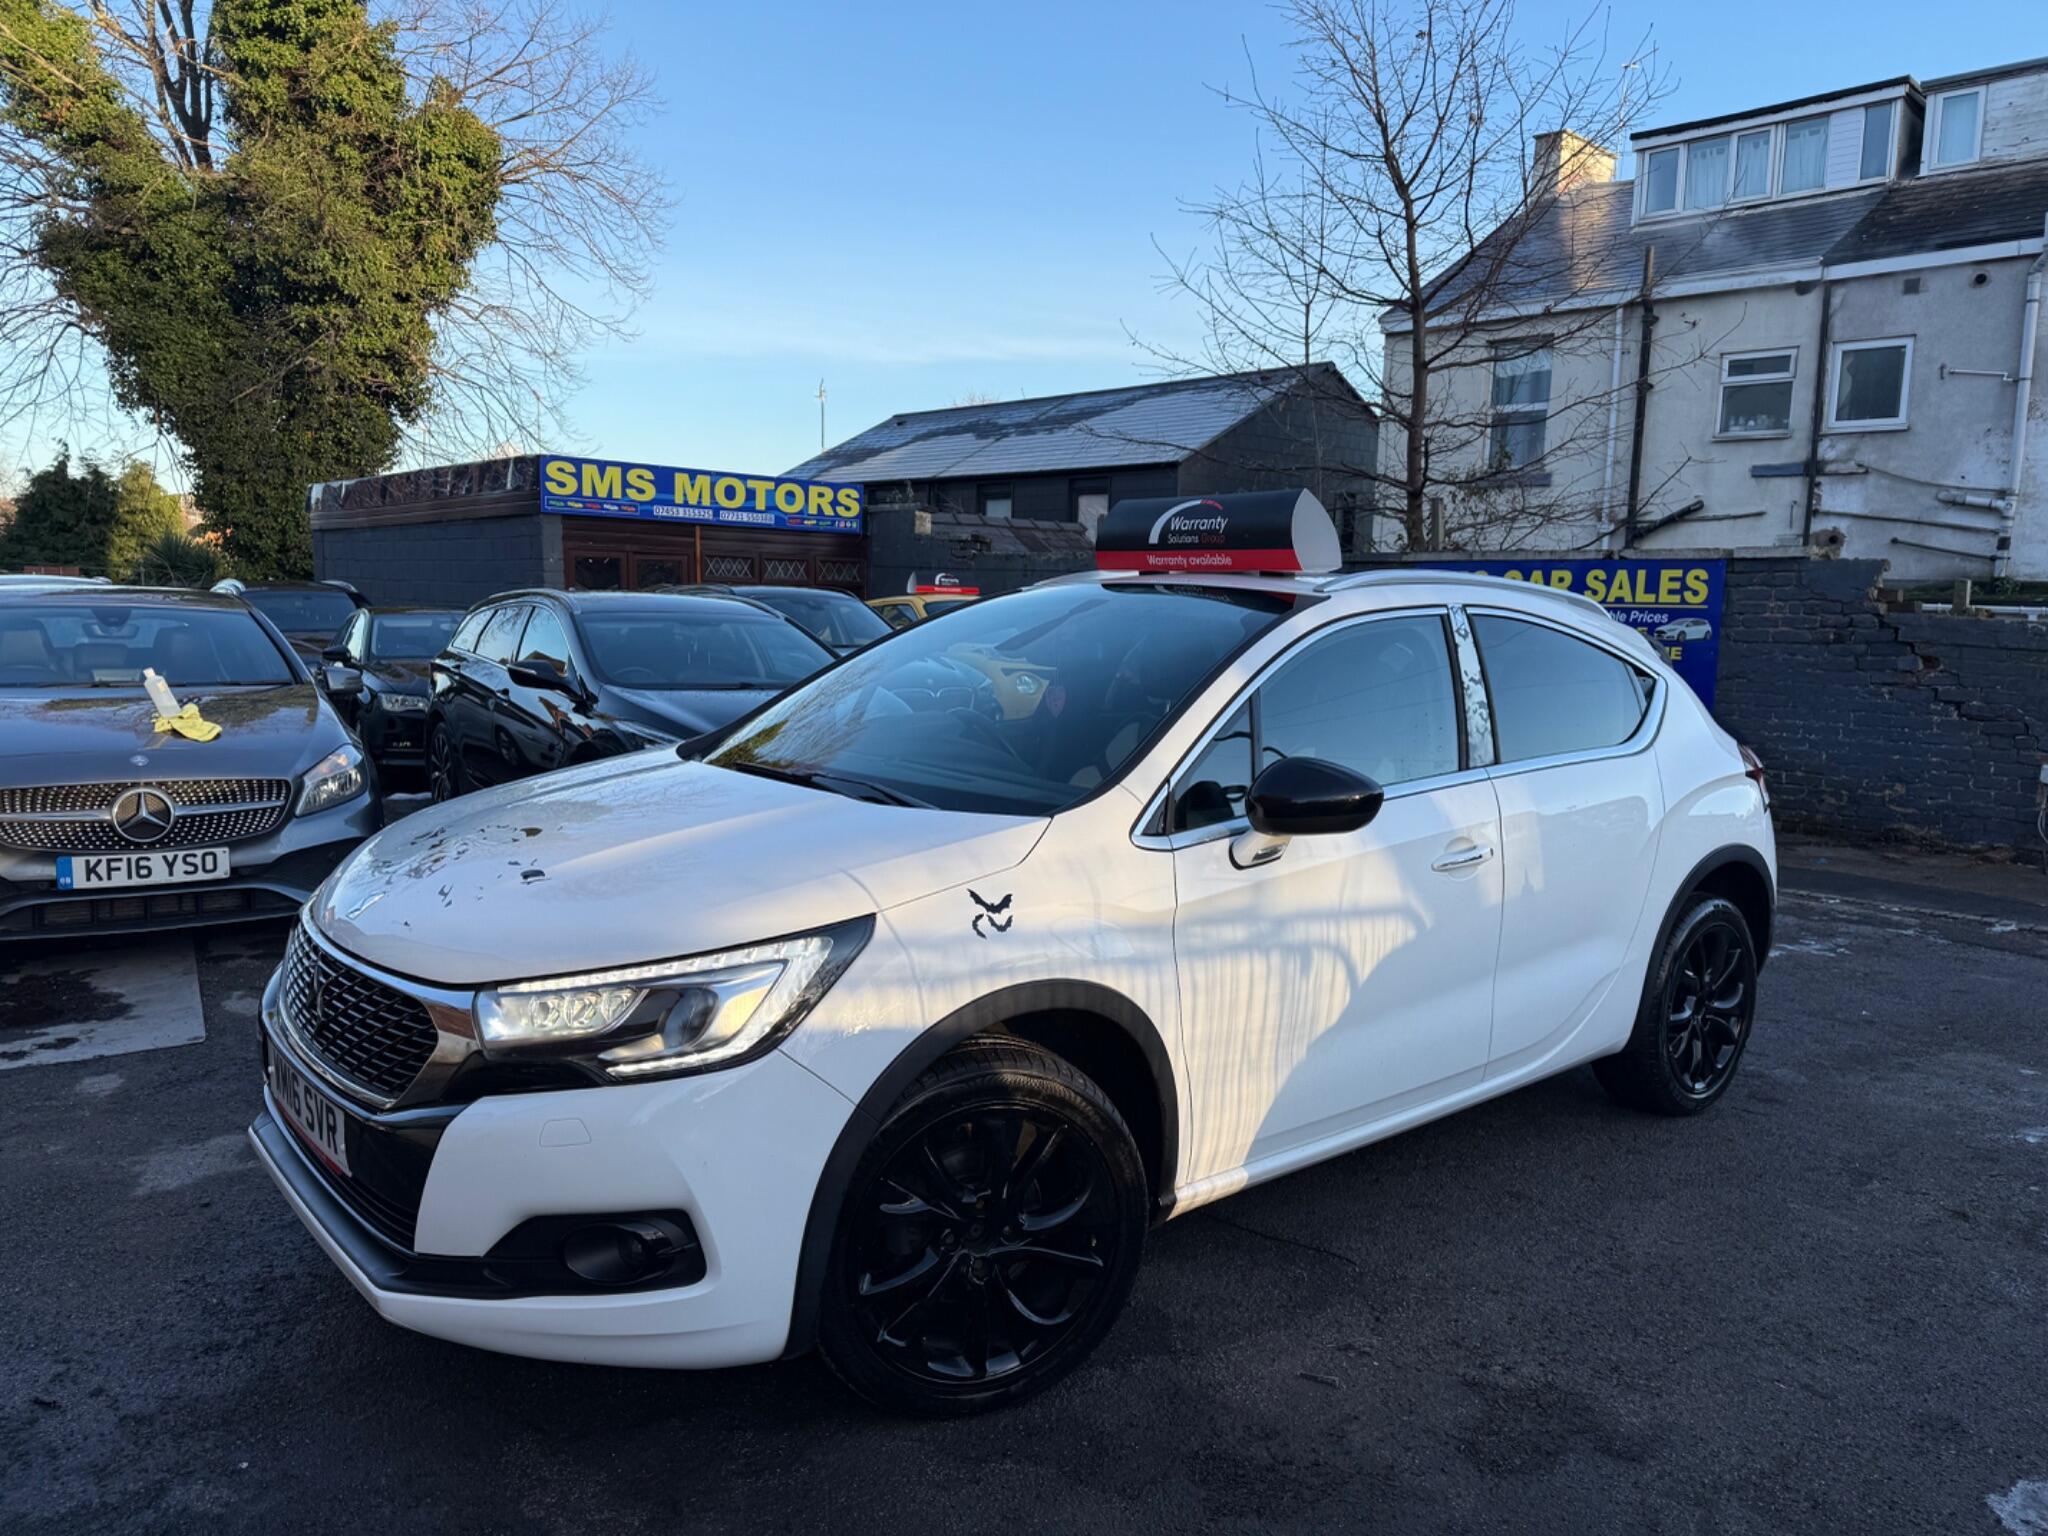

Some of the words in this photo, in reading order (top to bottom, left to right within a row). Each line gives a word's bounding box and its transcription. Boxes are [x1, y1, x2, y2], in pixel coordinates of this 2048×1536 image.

[544, 460, 656, 502] SMS
[674, 472, 860, 518] MOTORS
[1170, 515, 1229, 534] Warranty
[1167, 533, 1199, 544] Solutions
[1147, 554, 1187, 568] Warranty
[1189, 553, 1232, 566] available
[1584, 568, 1709, 604] SALES
[1629, 610, 1669, 623] Prices
[84, 855, 153, 882] KF16
[162, 850, 218, 878] YSO
[303, 1083, 338, 1155] SVR
